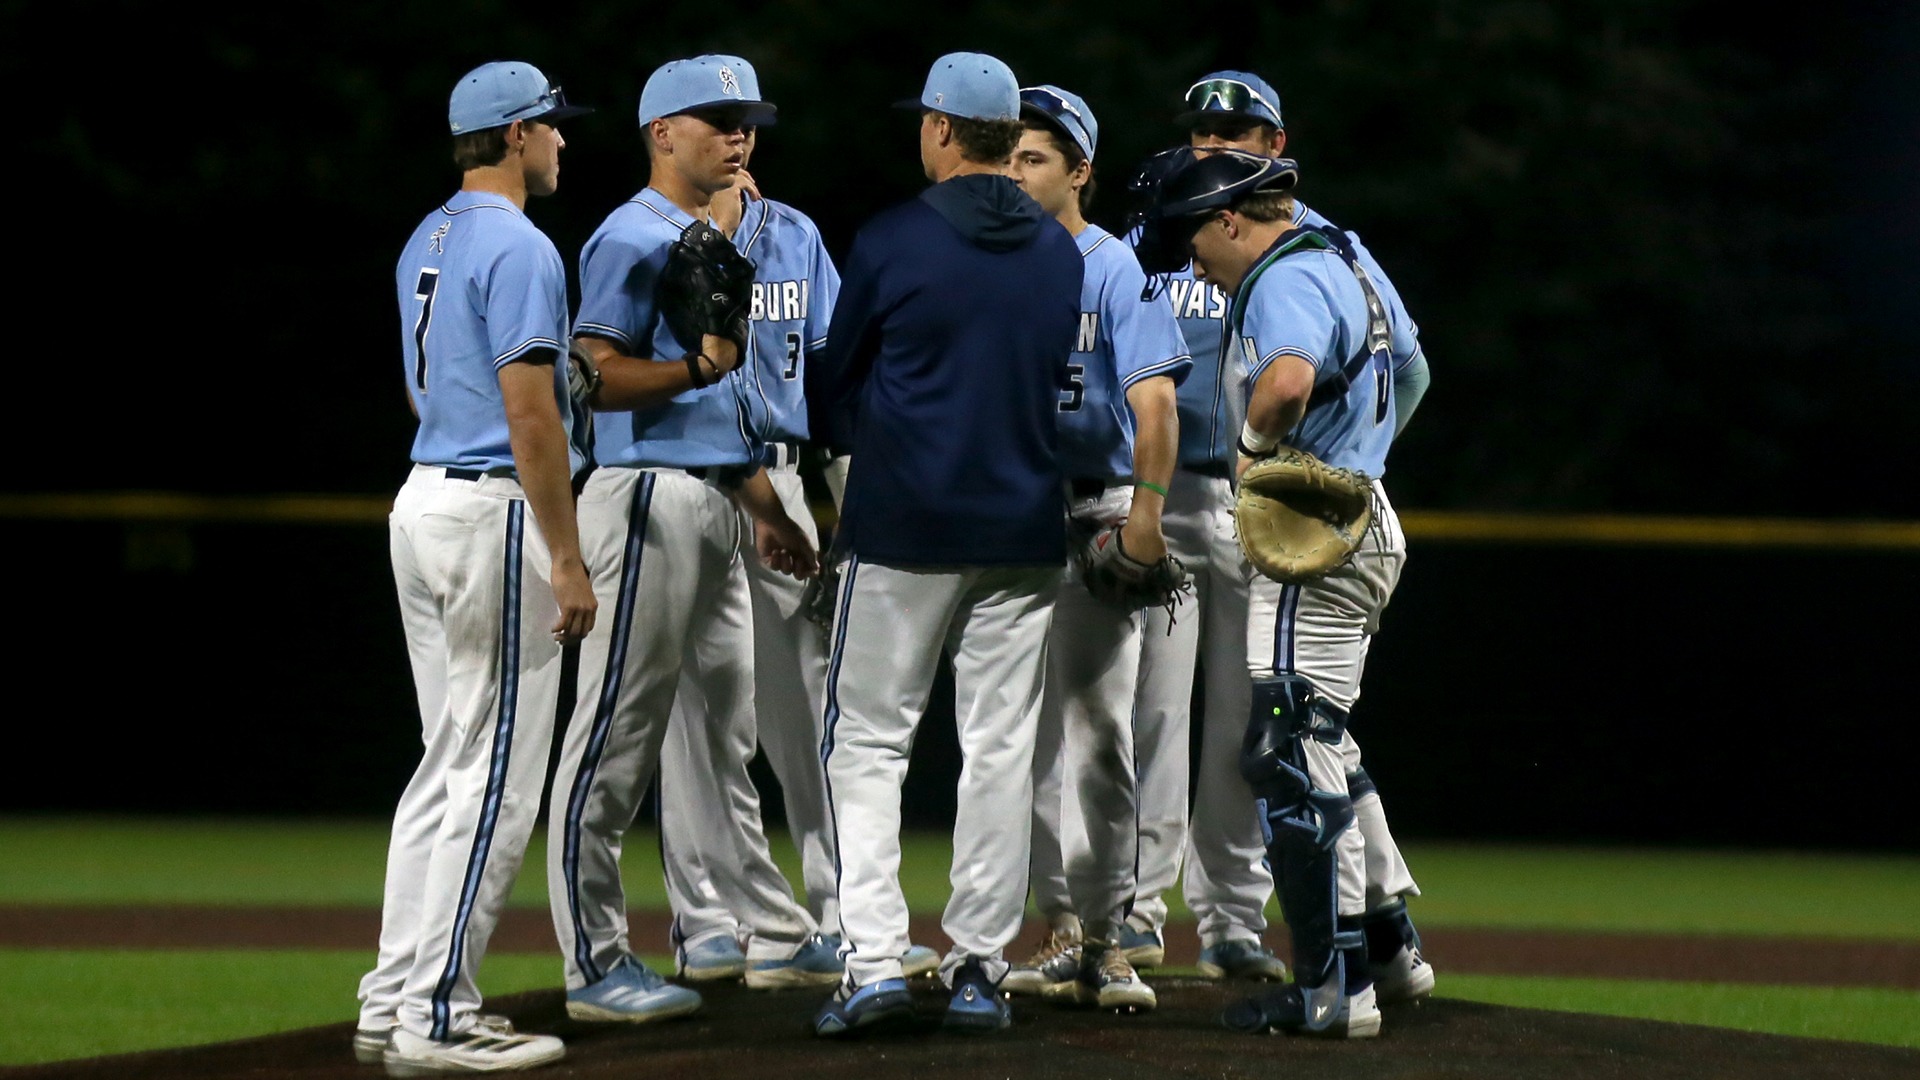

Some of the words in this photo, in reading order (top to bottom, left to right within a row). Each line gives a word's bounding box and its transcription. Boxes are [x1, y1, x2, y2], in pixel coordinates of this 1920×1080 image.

[414, 267, 440, 395] 7
[784, 331, 801, 382] 3
[1057, 363, 1086, 414] 5
